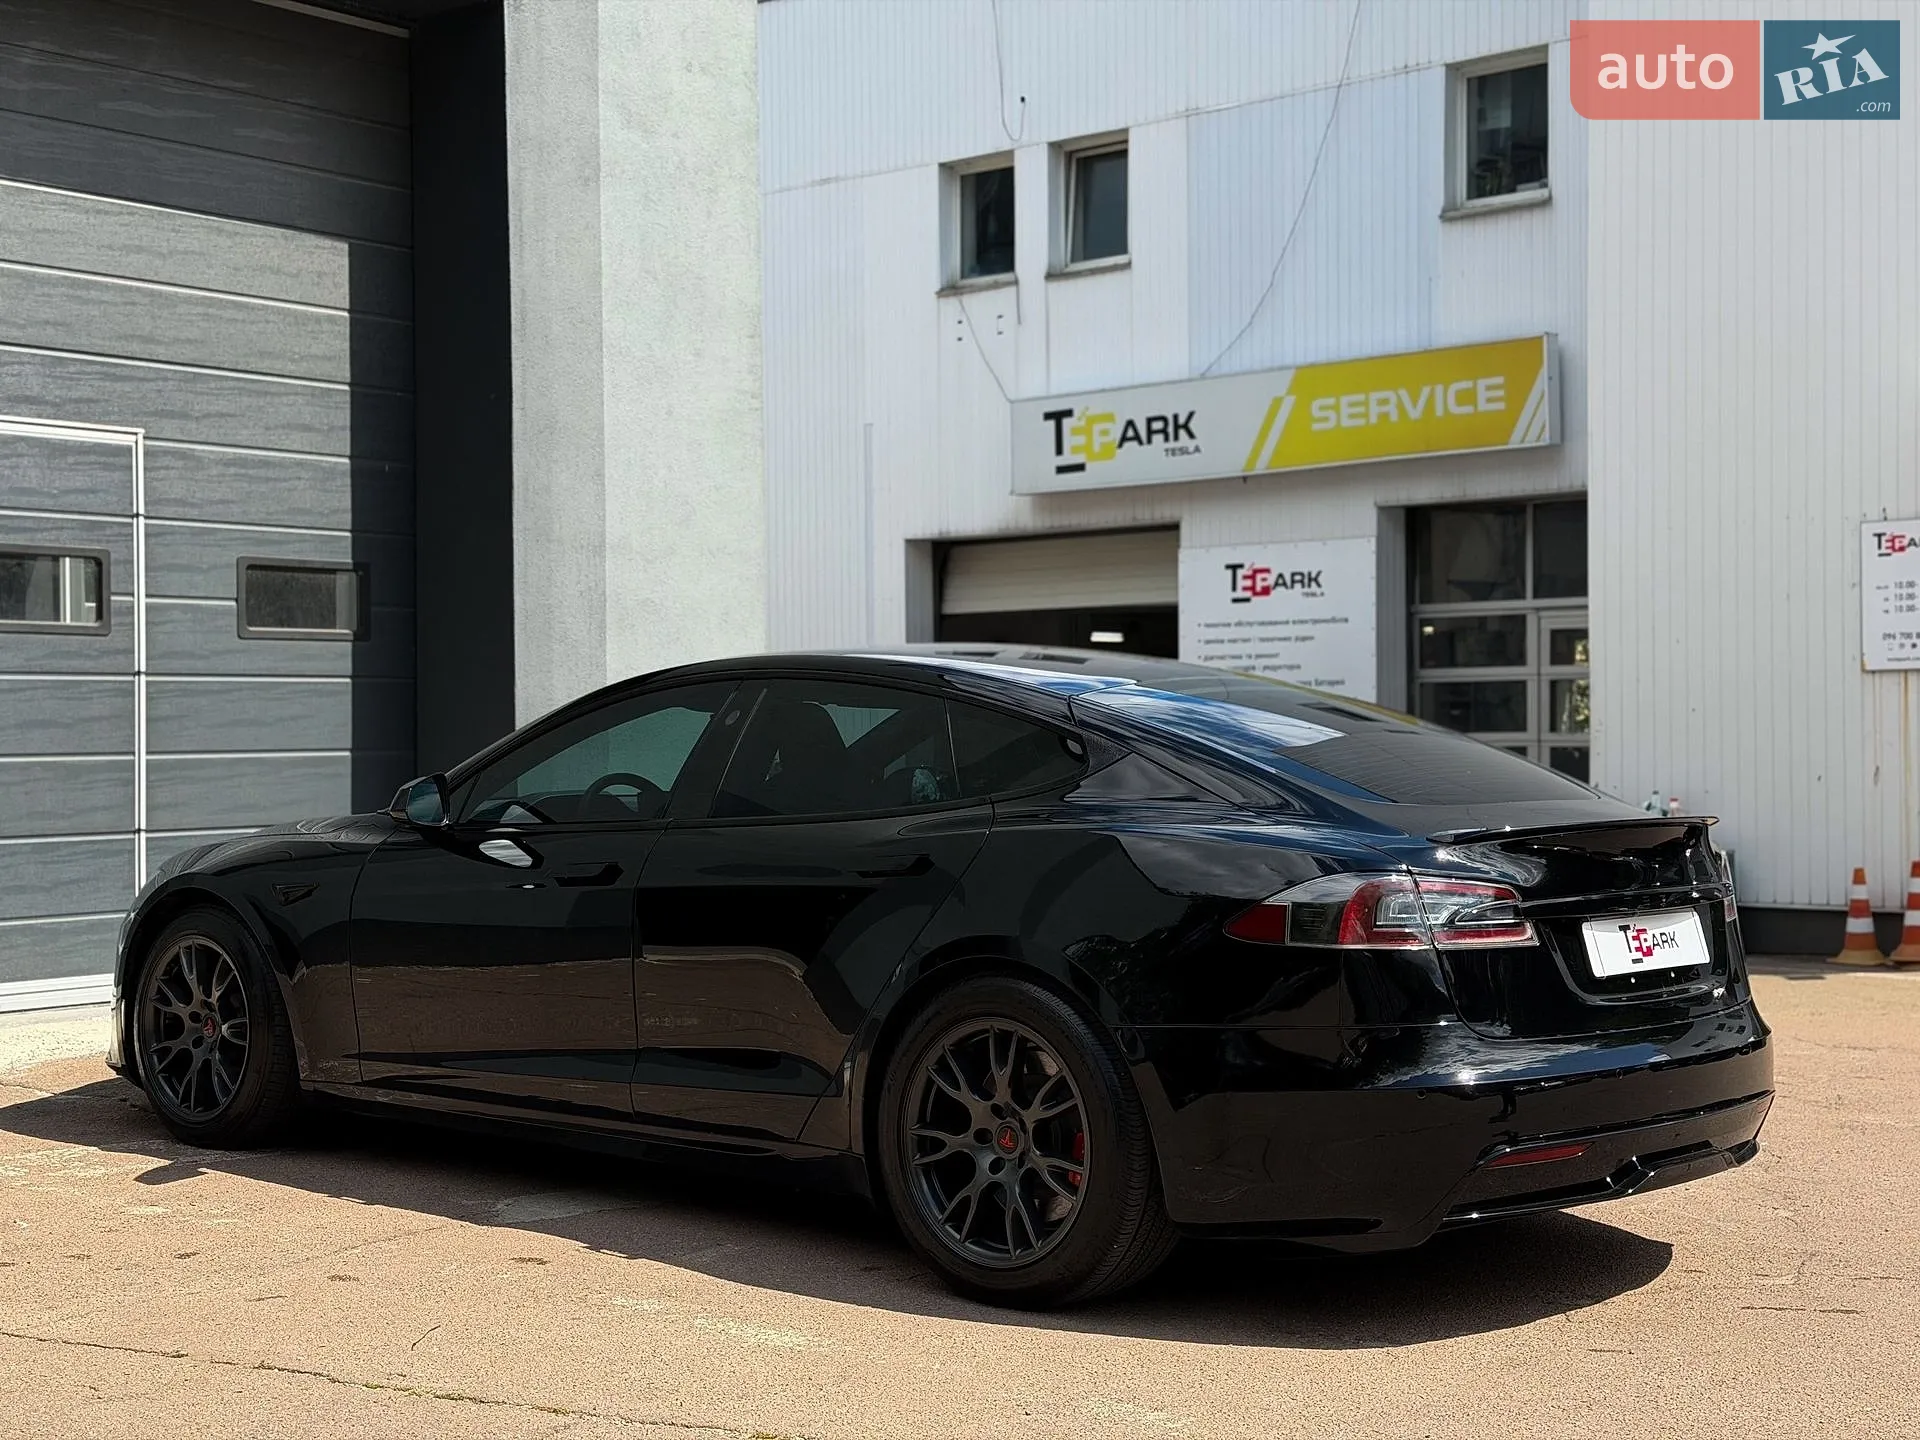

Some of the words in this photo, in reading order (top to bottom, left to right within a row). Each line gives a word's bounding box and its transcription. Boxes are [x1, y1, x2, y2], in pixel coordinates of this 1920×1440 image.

[1310, 376, 1506, 432] SERVICE
[1164, 445, 1201, 458] TESLA
[1872, 532, 1920, 552] TEPA
